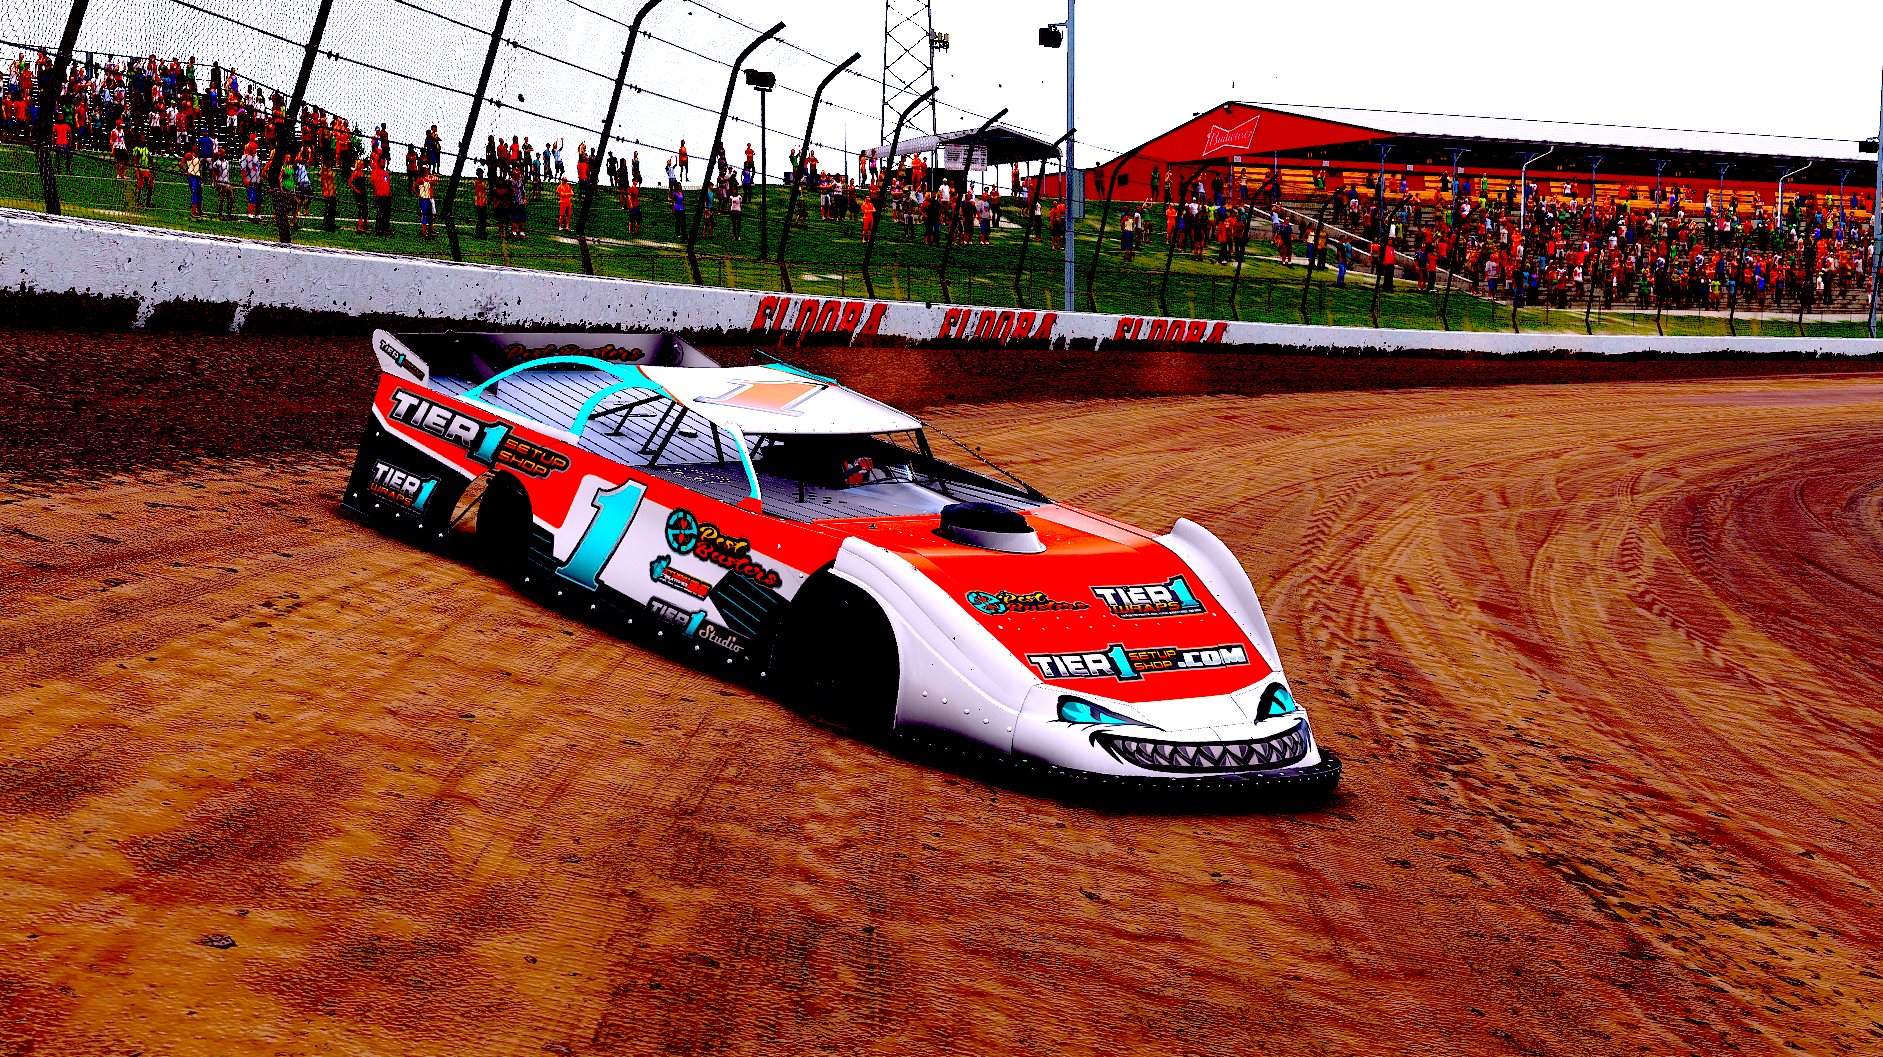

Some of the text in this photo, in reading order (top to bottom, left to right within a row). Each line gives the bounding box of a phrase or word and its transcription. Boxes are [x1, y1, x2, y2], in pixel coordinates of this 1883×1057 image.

[498, 450, 548, 477] SHOP
[504, 438, 567, 468] SETUP
[370, 483, 413, 506] WRAPS
[555, 478, 648, 591] 1
[700, 525, 748, 556] Pest
[695, 541, 779, 585] Busters
[1112, 602, 1181, 614] WRAPS
[699, 624, 745, 653] Studio
[1128, 649, 1177, 661] SETUP
[1133, 660, 1173, 671] SHOP
